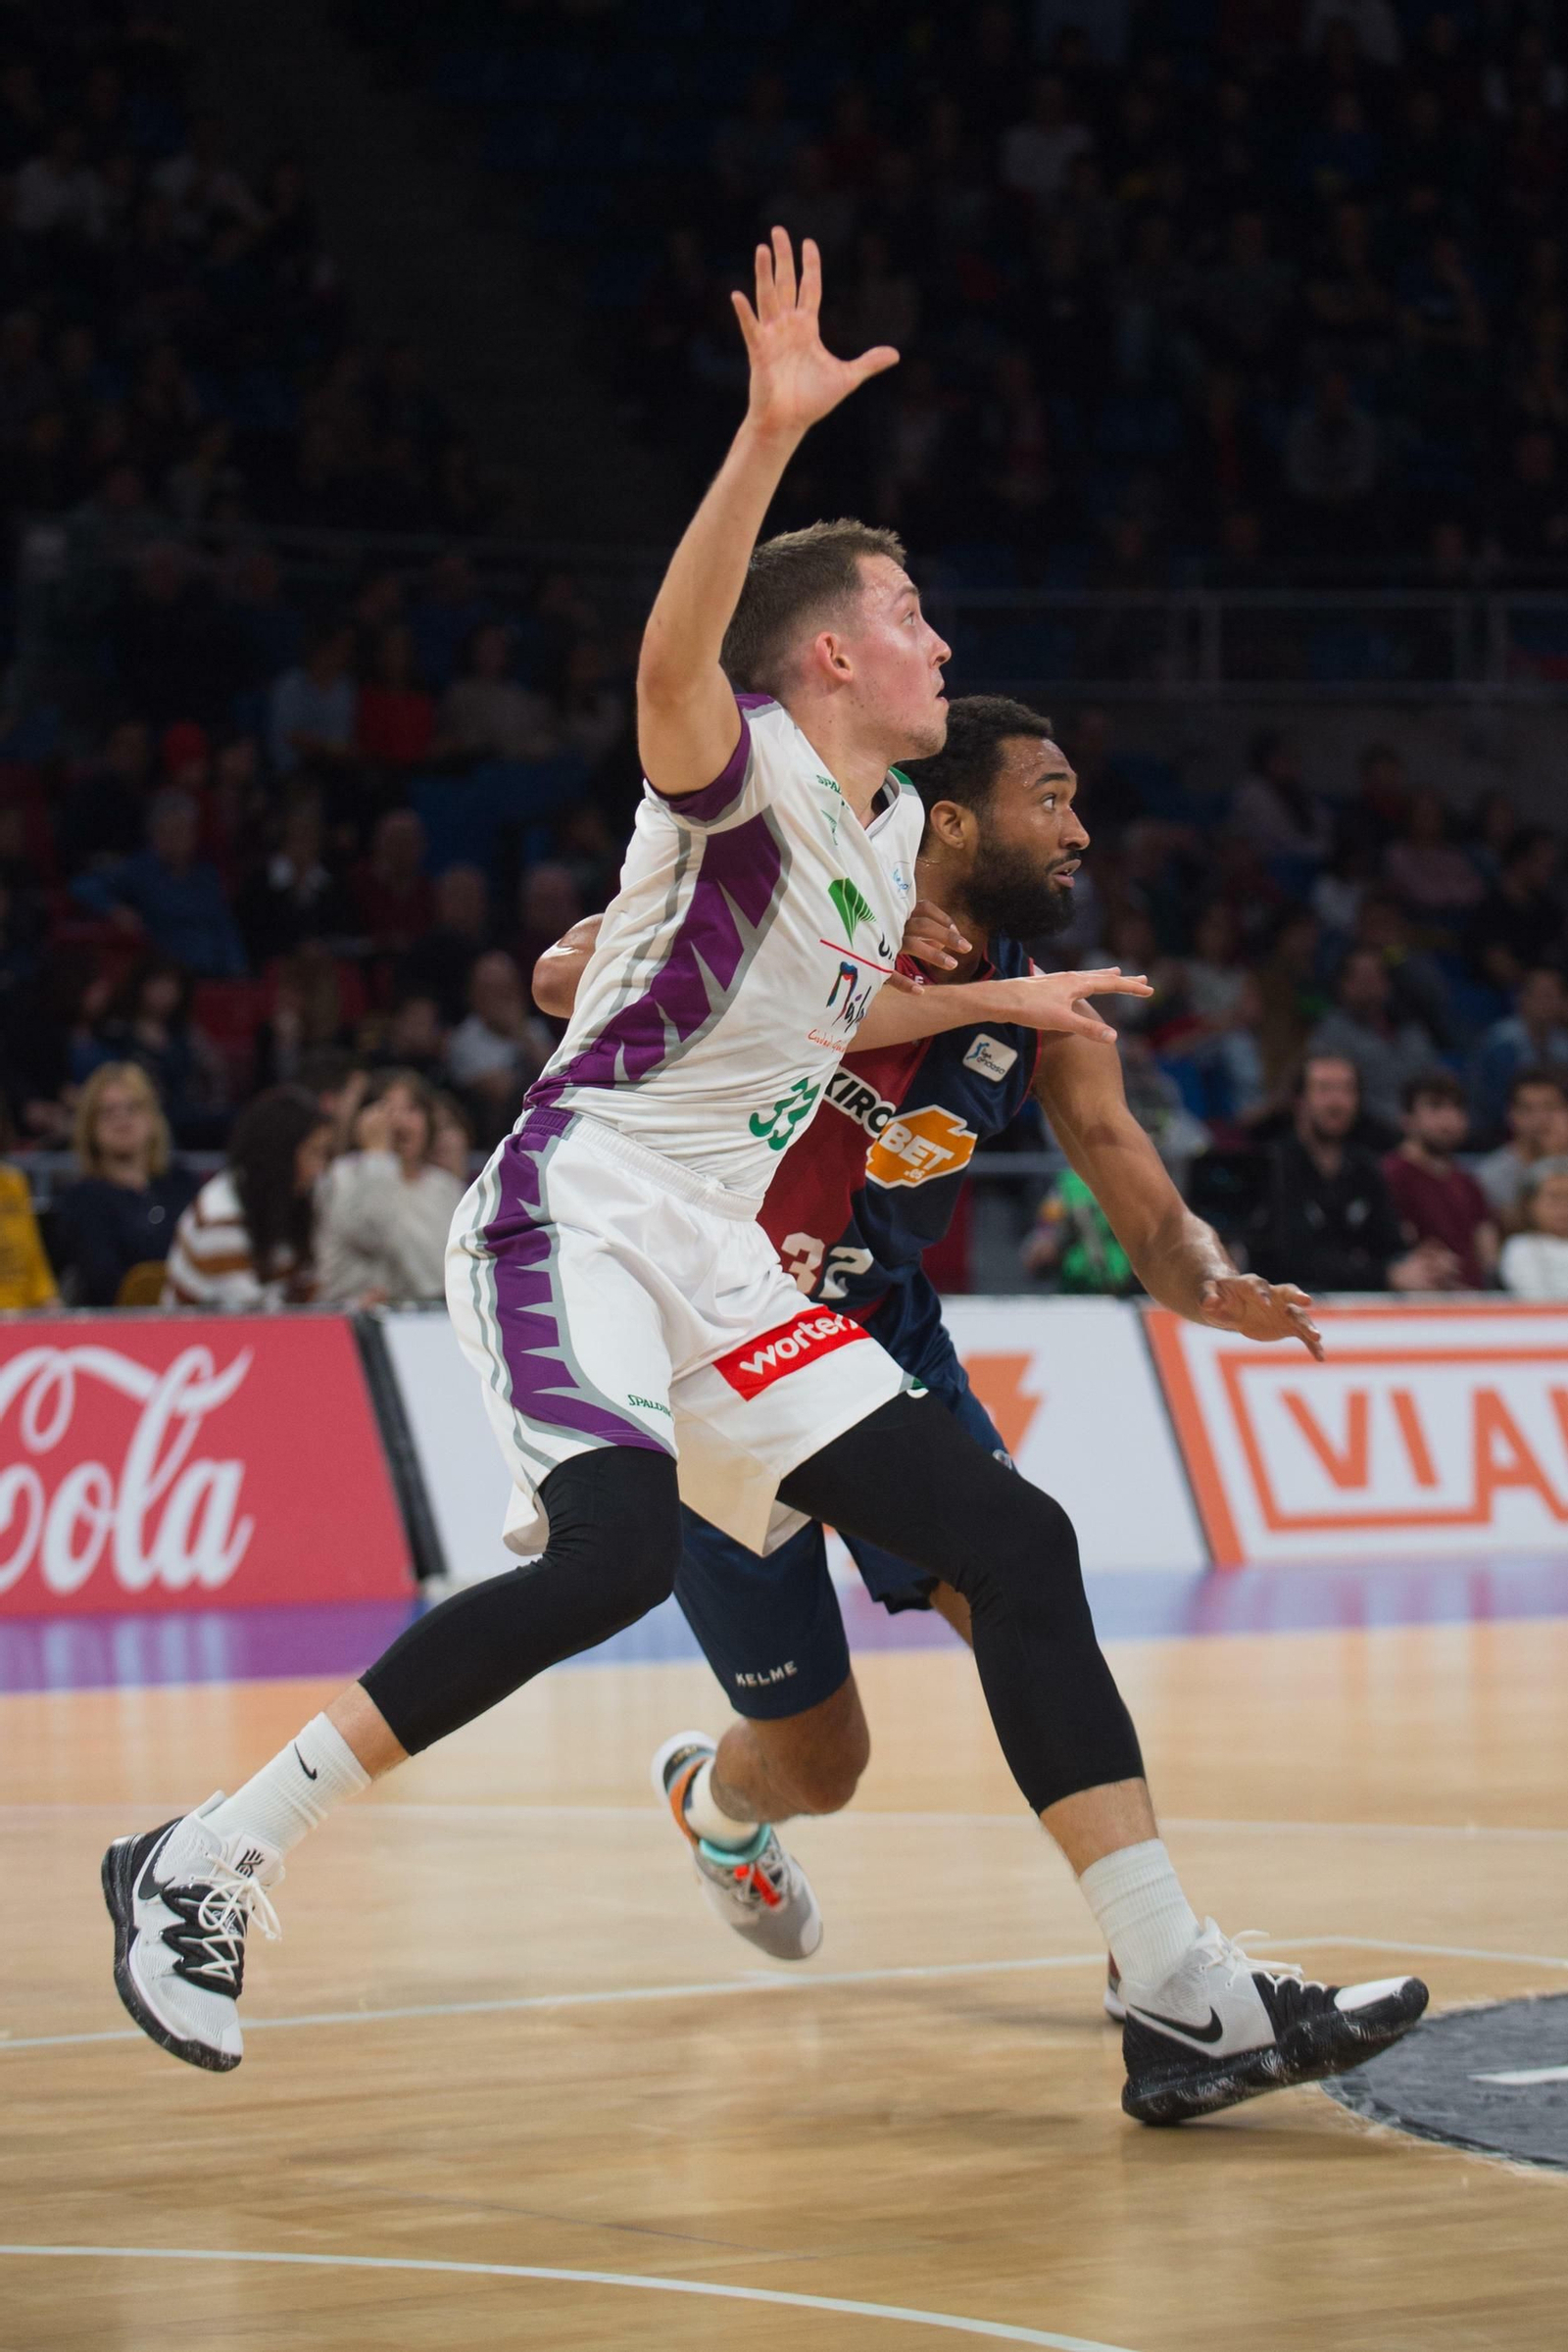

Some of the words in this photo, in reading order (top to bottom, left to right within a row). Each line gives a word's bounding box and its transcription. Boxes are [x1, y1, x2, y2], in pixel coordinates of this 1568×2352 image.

[749, 1077, 820, 1151] 33
[824, 1072, 893, 1137] KIRO
[879, 1122, 956, 1170] BET
[781, 1232, 874, 1298] 32
[627, 1394, 674, 1422] SPALDIN
[1280, 1387, 1568, 1525] VIA
[735, 1660, 798, 1688] KELME
